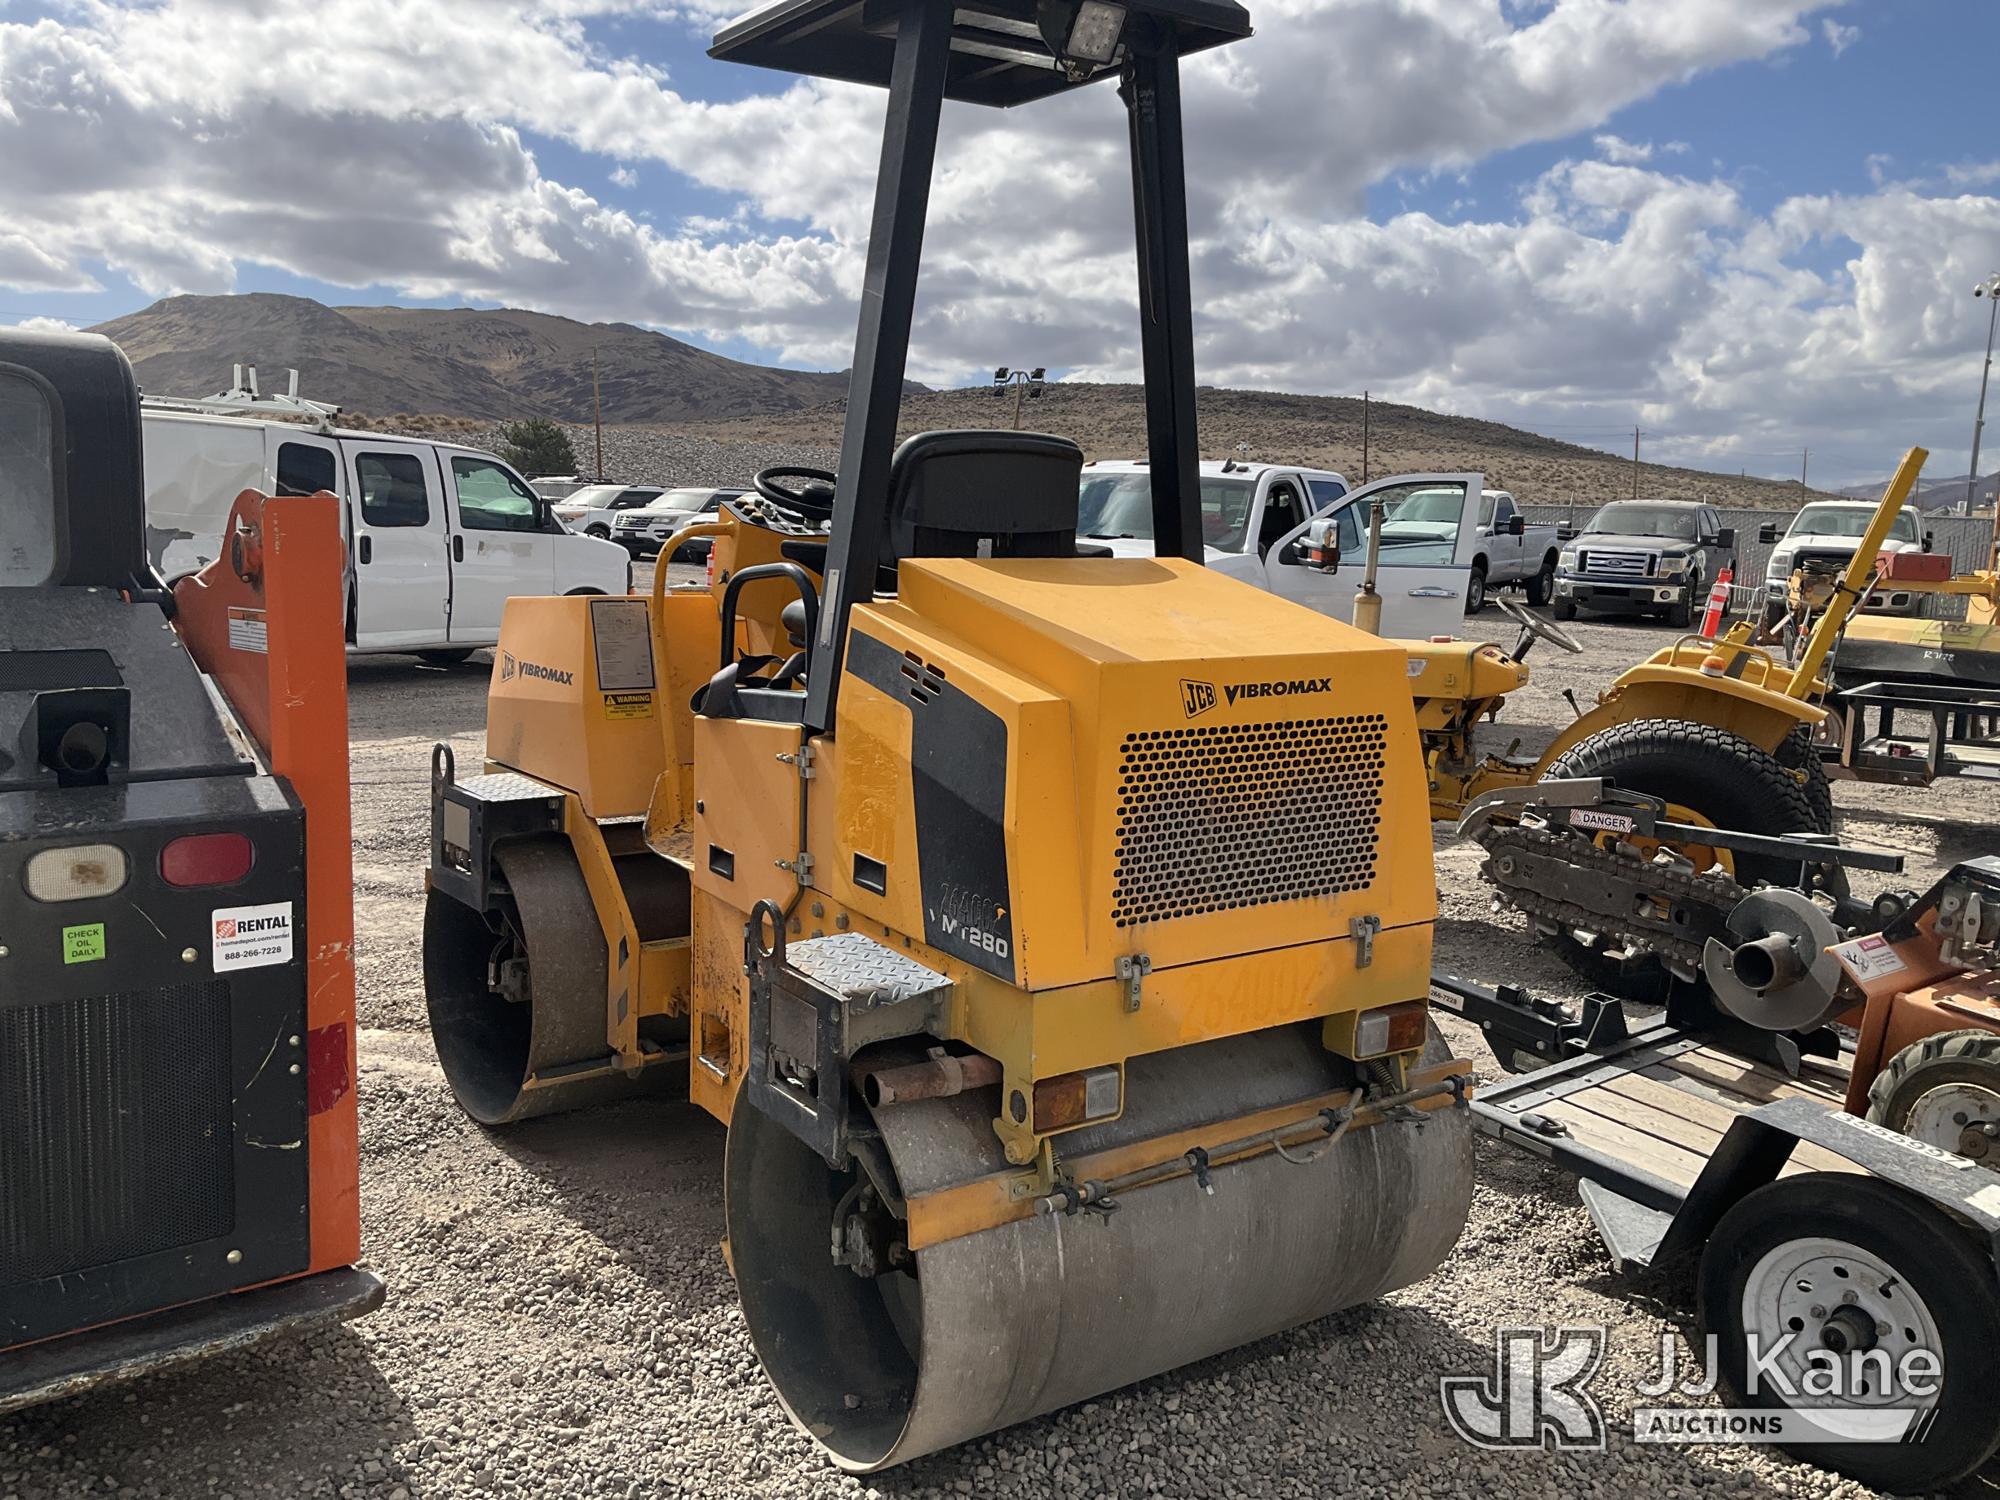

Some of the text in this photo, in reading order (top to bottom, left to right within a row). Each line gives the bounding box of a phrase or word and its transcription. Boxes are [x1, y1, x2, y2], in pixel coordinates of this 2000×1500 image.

[502, 653, 574, 686] JCB VIBROMAX
[616, 695, 650, 704] WARNING
[1186, 678, 1332, 714] JCB VIBROMAX
[1583, 814, 1626, 829] DANGER
[238, 916, 289, 933] RENTAL
[67, 929, 99, 939] CHECK
[72, 948, 97, 957] DAILY
[225, 946, 282, 960] 888-266-7228
